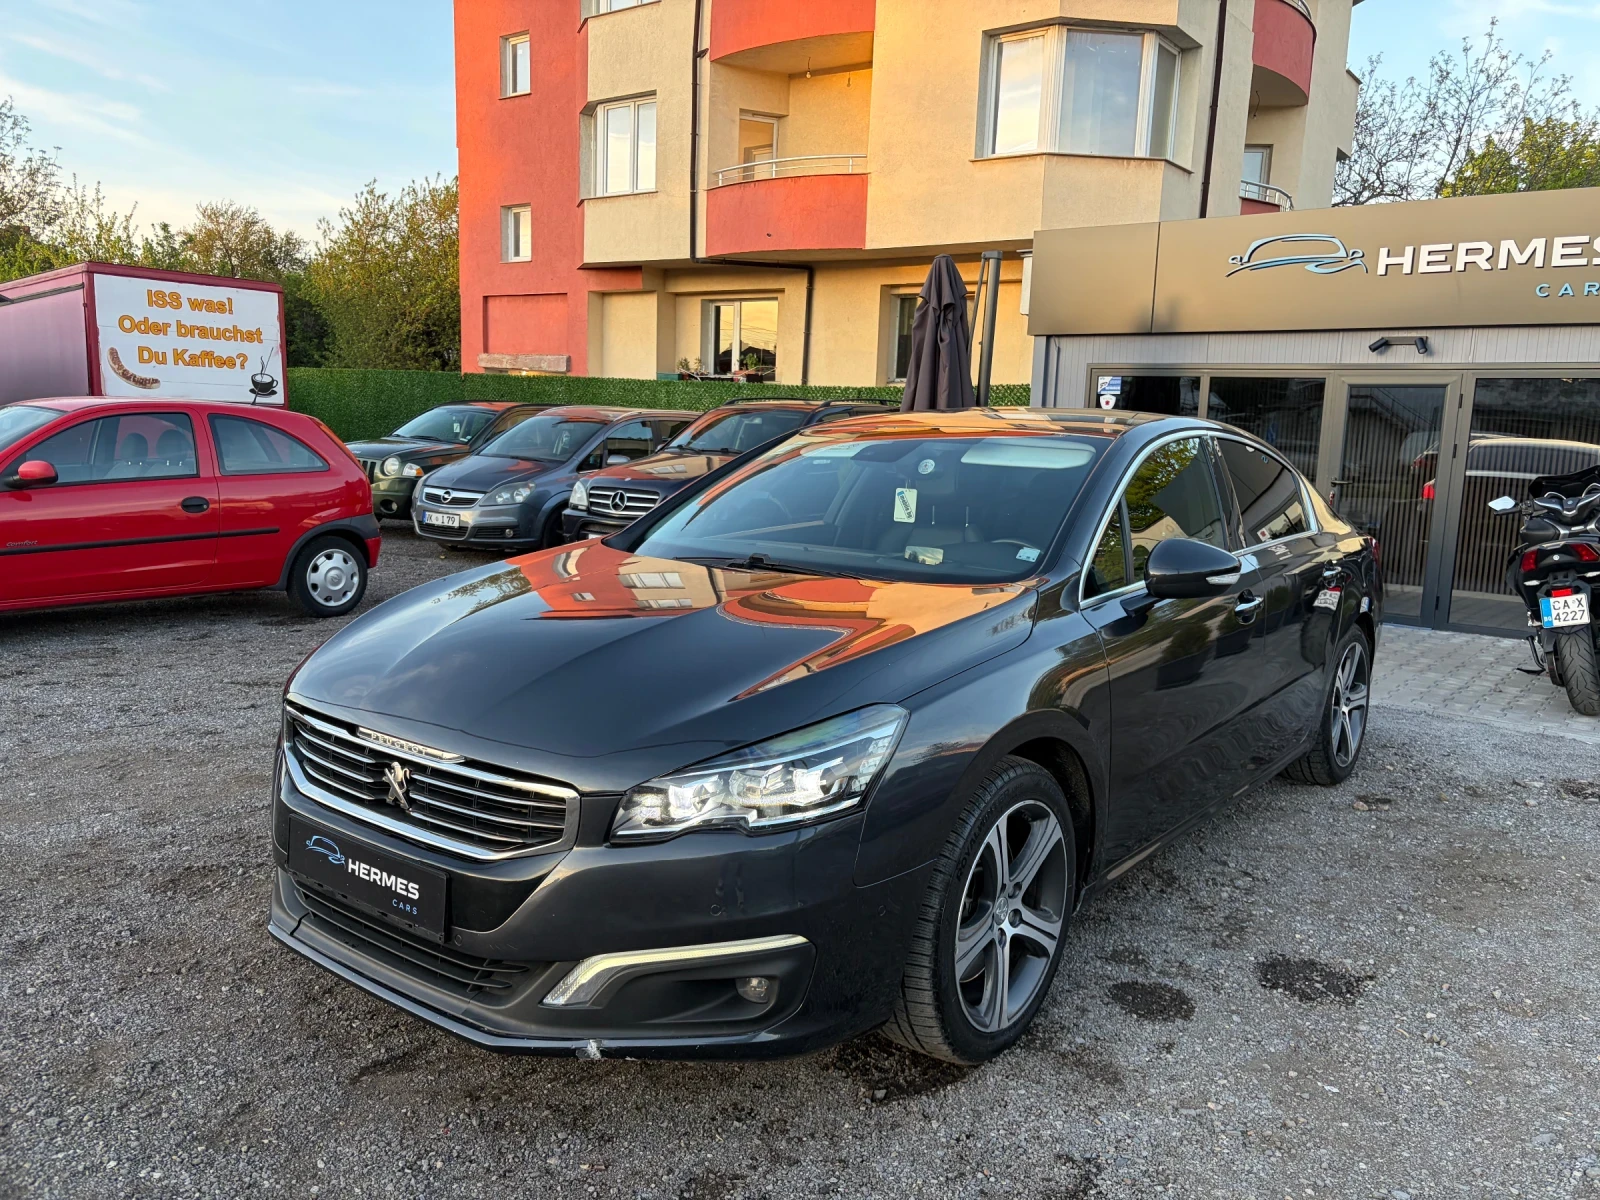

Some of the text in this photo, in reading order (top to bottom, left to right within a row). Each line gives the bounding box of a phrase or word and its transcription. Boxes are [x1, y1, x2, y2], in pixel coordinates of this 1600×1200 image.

[1376, 235, 1600, 276] HERME
[147, 289, 234, 315] ISS was!
[118, 315, 263, 344] Oder brauchst
[138, 346, 248, 370] Du Kaffee?
[1552, 600, 1570, 610] CA
[1554, 610, 1585, 622] 4227
[371, 732, 428, 755] PEUGEOT
[348, 858, 419, 900] HERMES
[392, 899, 418, 915] CARS
